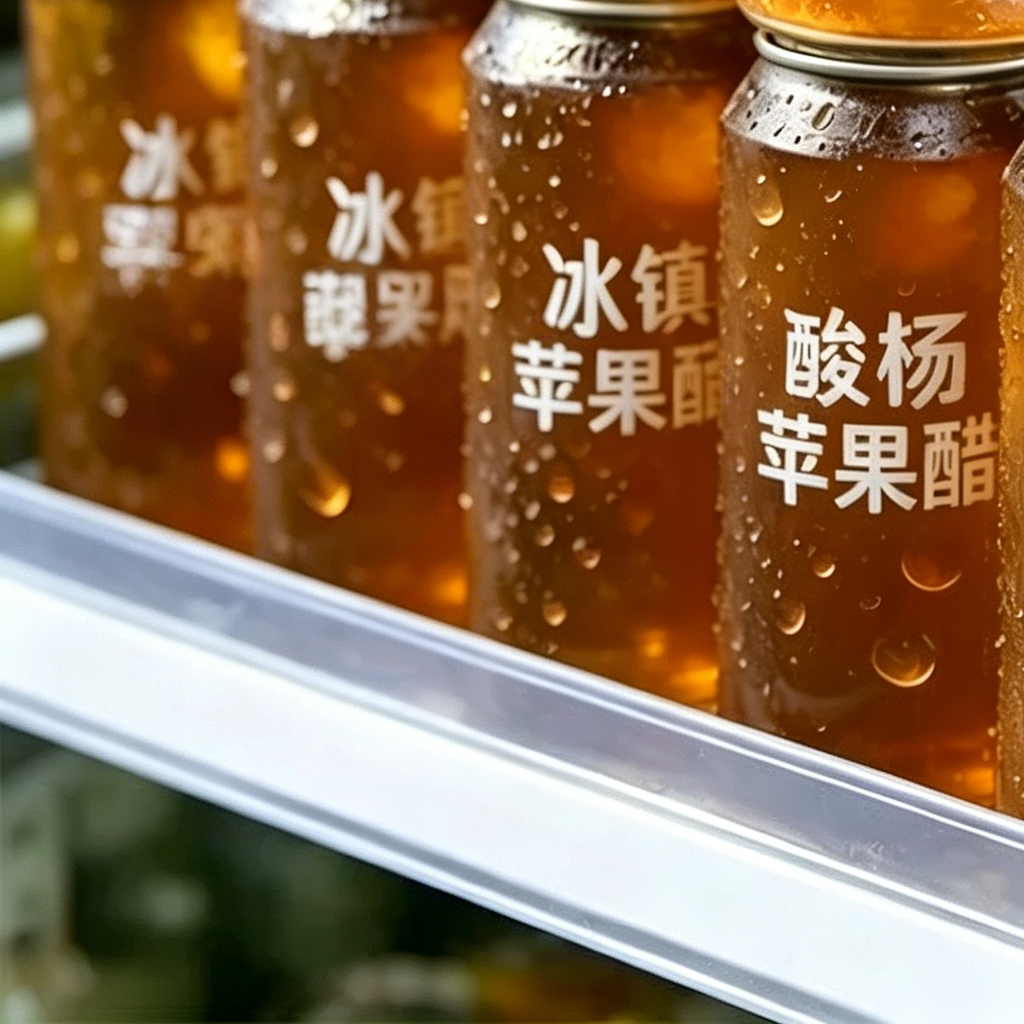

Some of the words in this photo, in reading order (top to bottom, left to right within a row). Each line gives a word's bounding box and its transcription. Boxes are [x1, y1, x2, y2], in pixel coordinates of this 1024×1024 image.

[543, 238, 717, 338] 冰镇
[784, 306, 968, 410] 酸杨
[757, 408, 998, 515] 苹果醋
